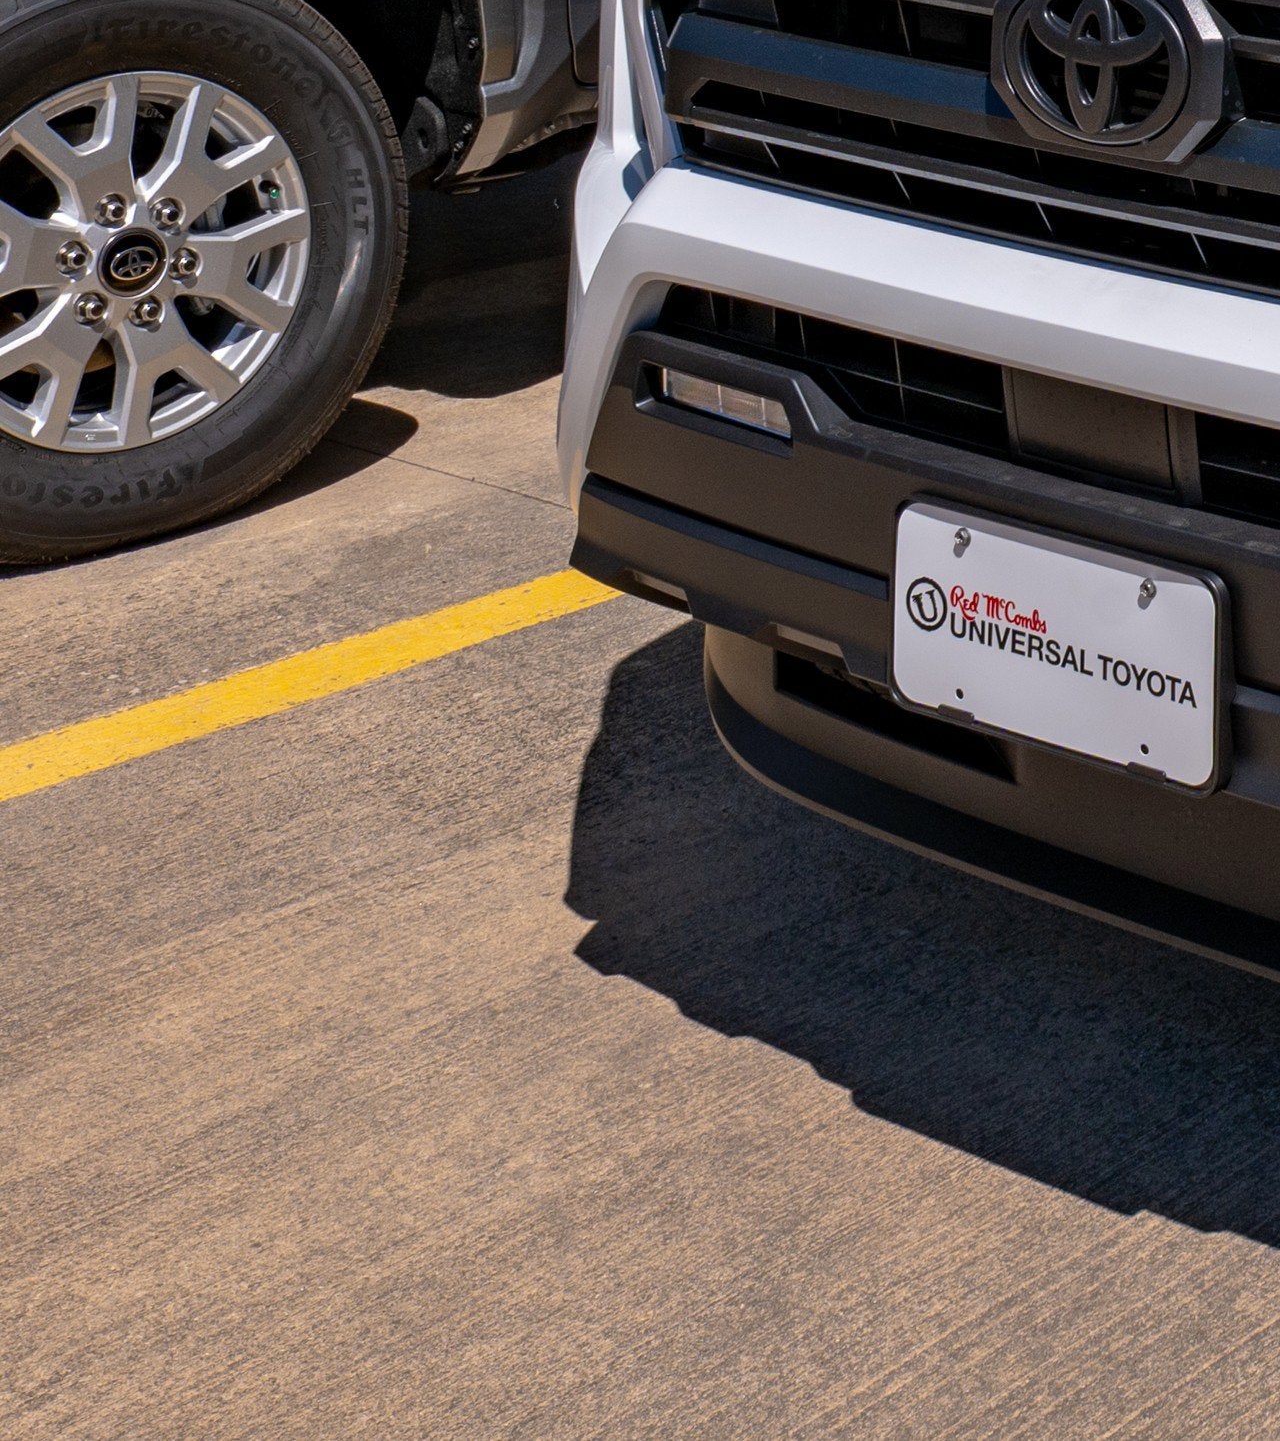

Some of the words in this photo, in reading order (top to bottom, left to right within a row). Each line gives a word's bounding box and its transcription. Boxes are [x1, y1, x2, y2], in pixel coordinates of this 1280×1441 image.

[950, 585, 980, 621] Red
[982, 591, 1047, 634] McCombs
[950, 611, 1094, 677] UNIVERSAL
[1097, 654, 1198, 708] TOYOTA
